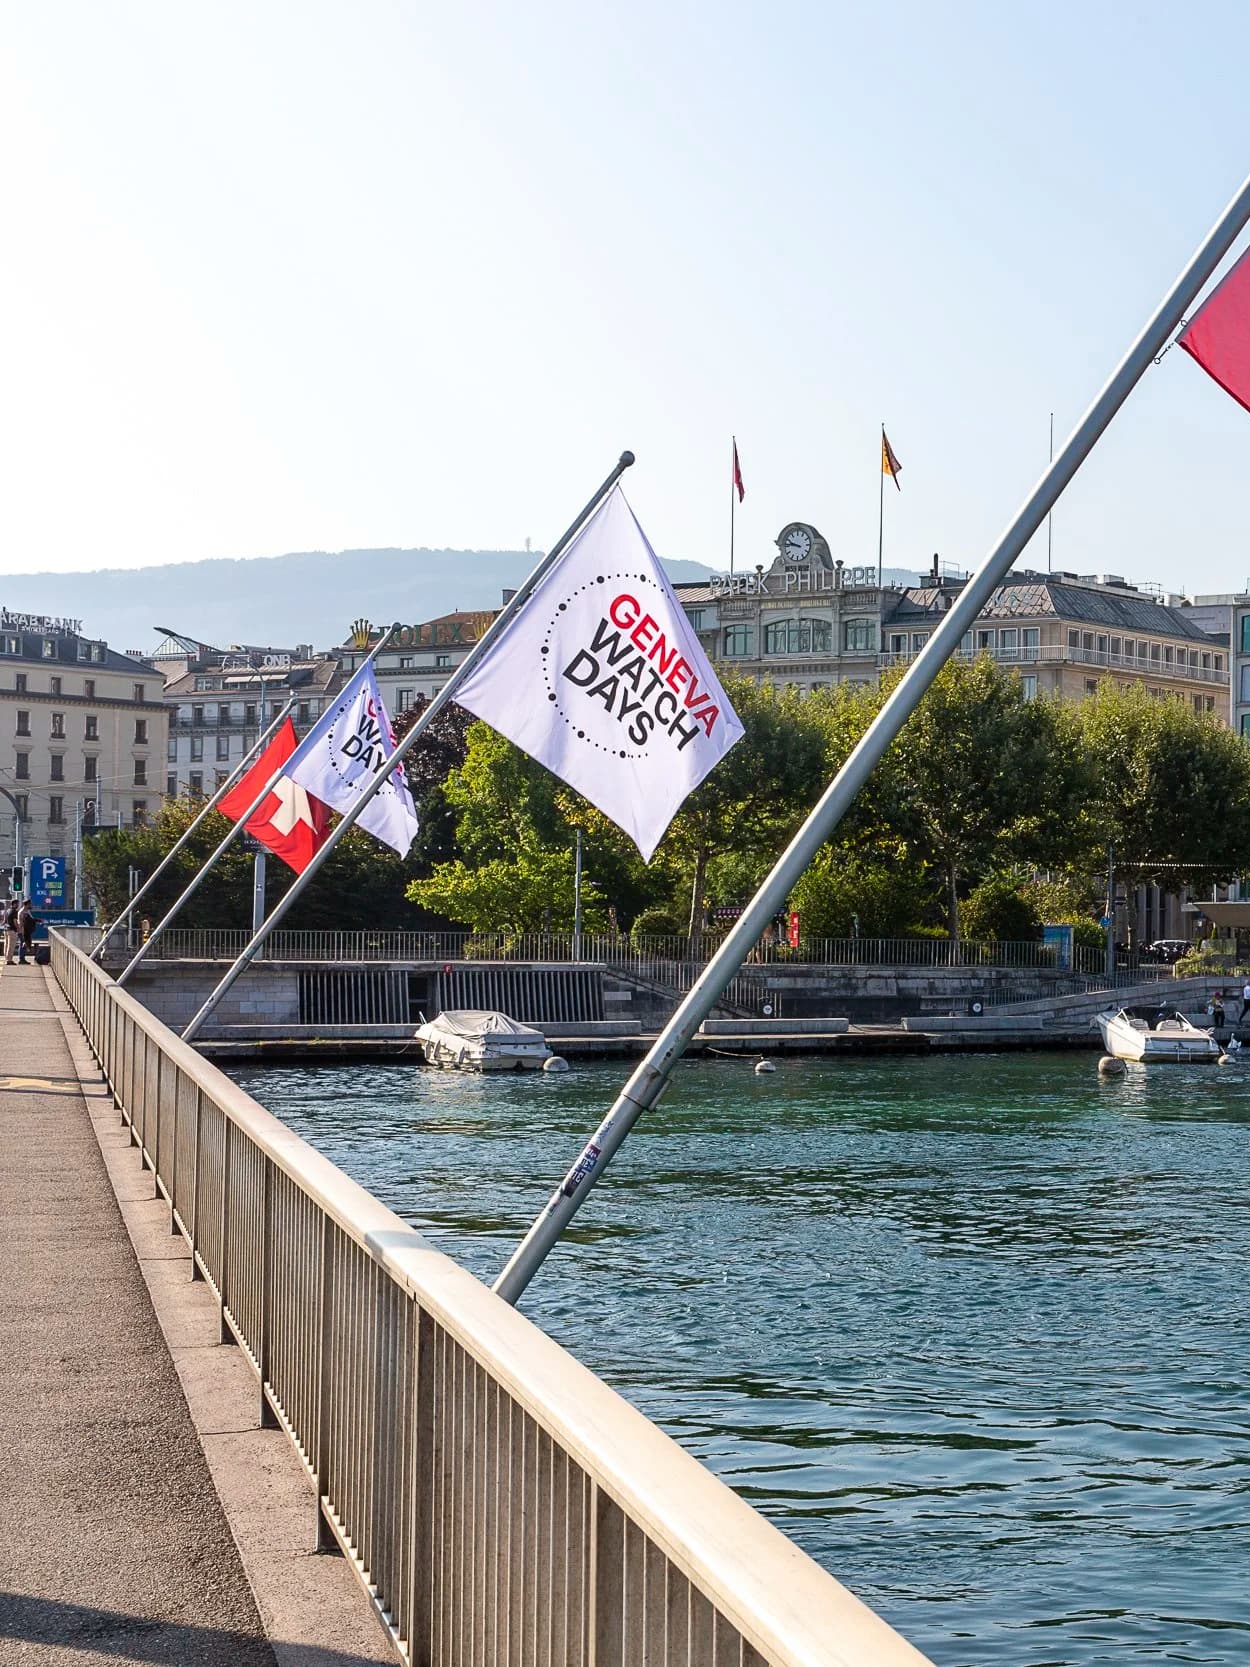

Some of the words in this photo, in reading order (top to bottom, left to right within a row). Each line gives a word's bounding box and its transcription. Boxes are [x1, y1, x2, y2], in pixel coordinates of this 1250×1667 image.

[709, 572, 769, 597] PATEK
[785, 566, 876, 593] PHILIPPE
[0, 611, 39, 626] ARAB
[43, 615, 84, 631] BANK
[263, 654, 291, 667] QNB
[609, 594, 720, 738] GENEVA
[562, 648, 655, 746] DAYS
[590, 617, 700, 751] WATCH
[43, 863, 56, 879] P
